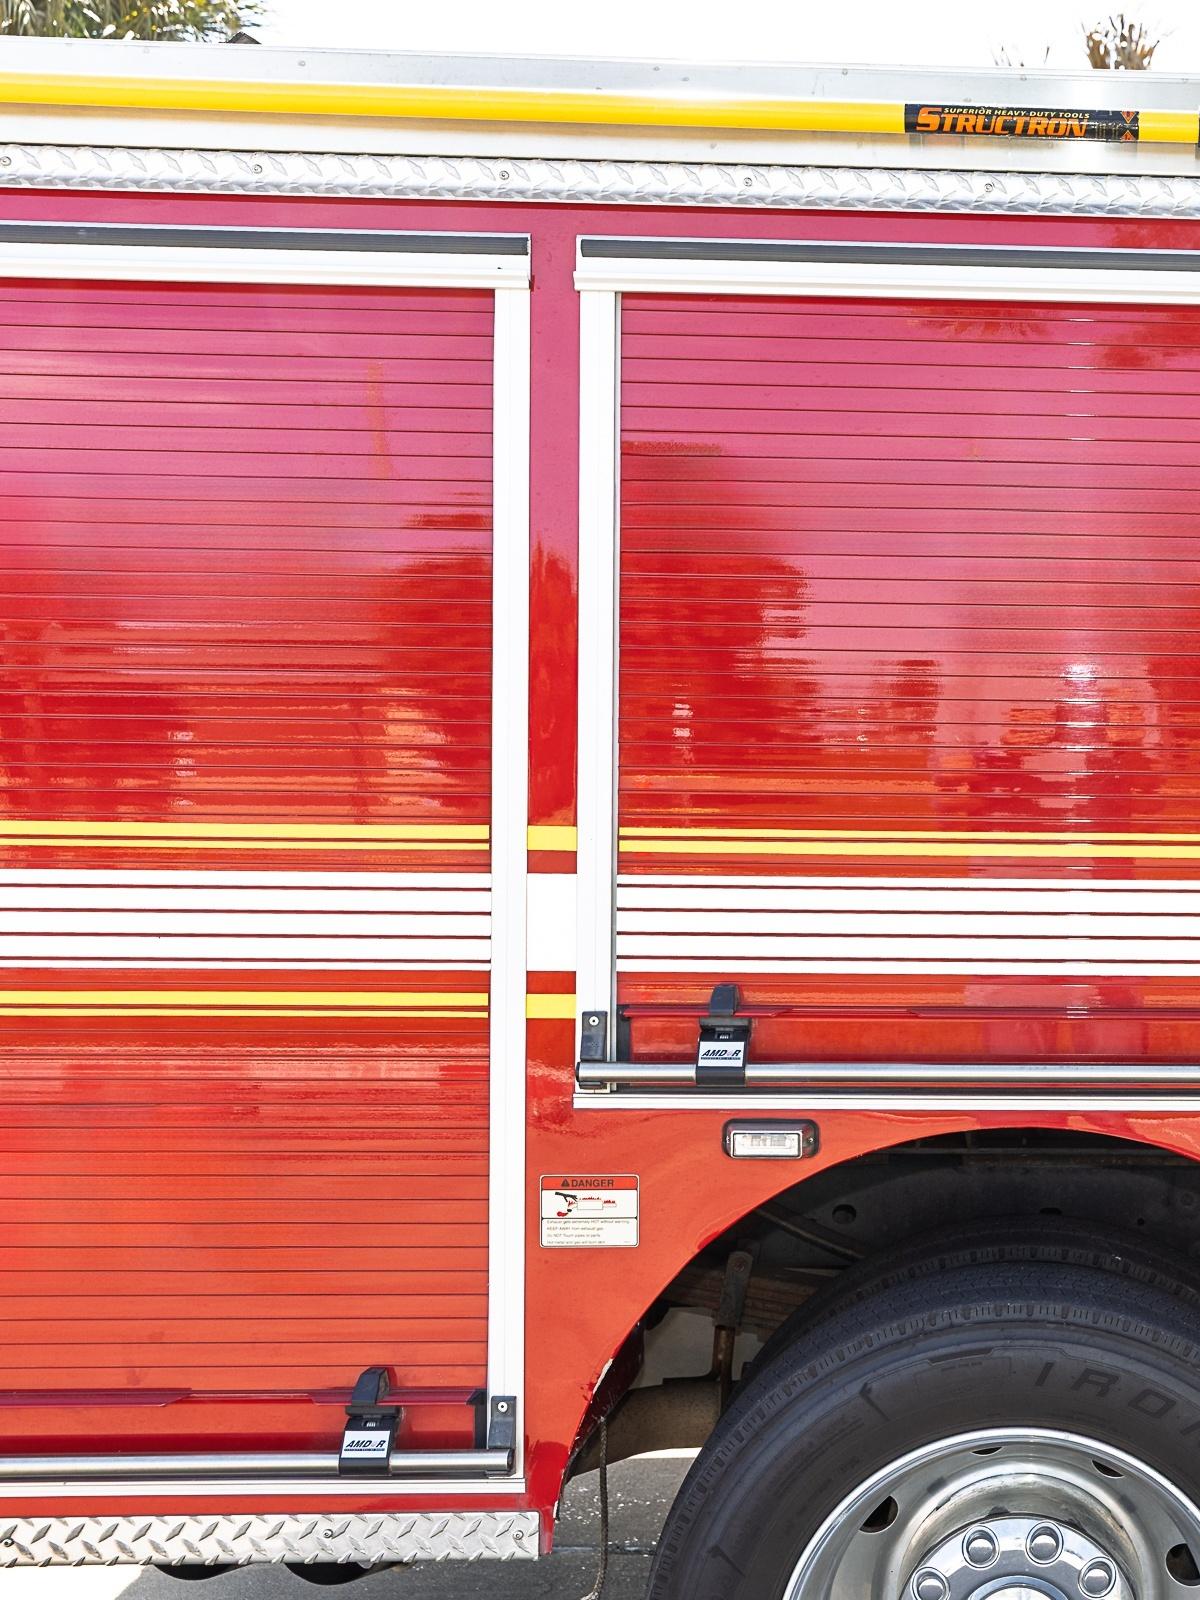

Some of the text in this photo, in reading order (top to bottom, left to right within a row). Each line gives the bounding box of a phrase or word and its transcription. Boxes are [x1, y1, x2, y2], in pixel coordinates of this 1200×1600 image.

[944, 106, 992, 115] SUPERIOR
[1060, 111, 1090, 119] TOOLS
[916, 107, 1088, 137] STRUCTRON
[701, 1049, 742, 1057] AMDR
[571, 1179, 614, 1187] DANGER
[345, 1440, 387, 1448] AMDR
